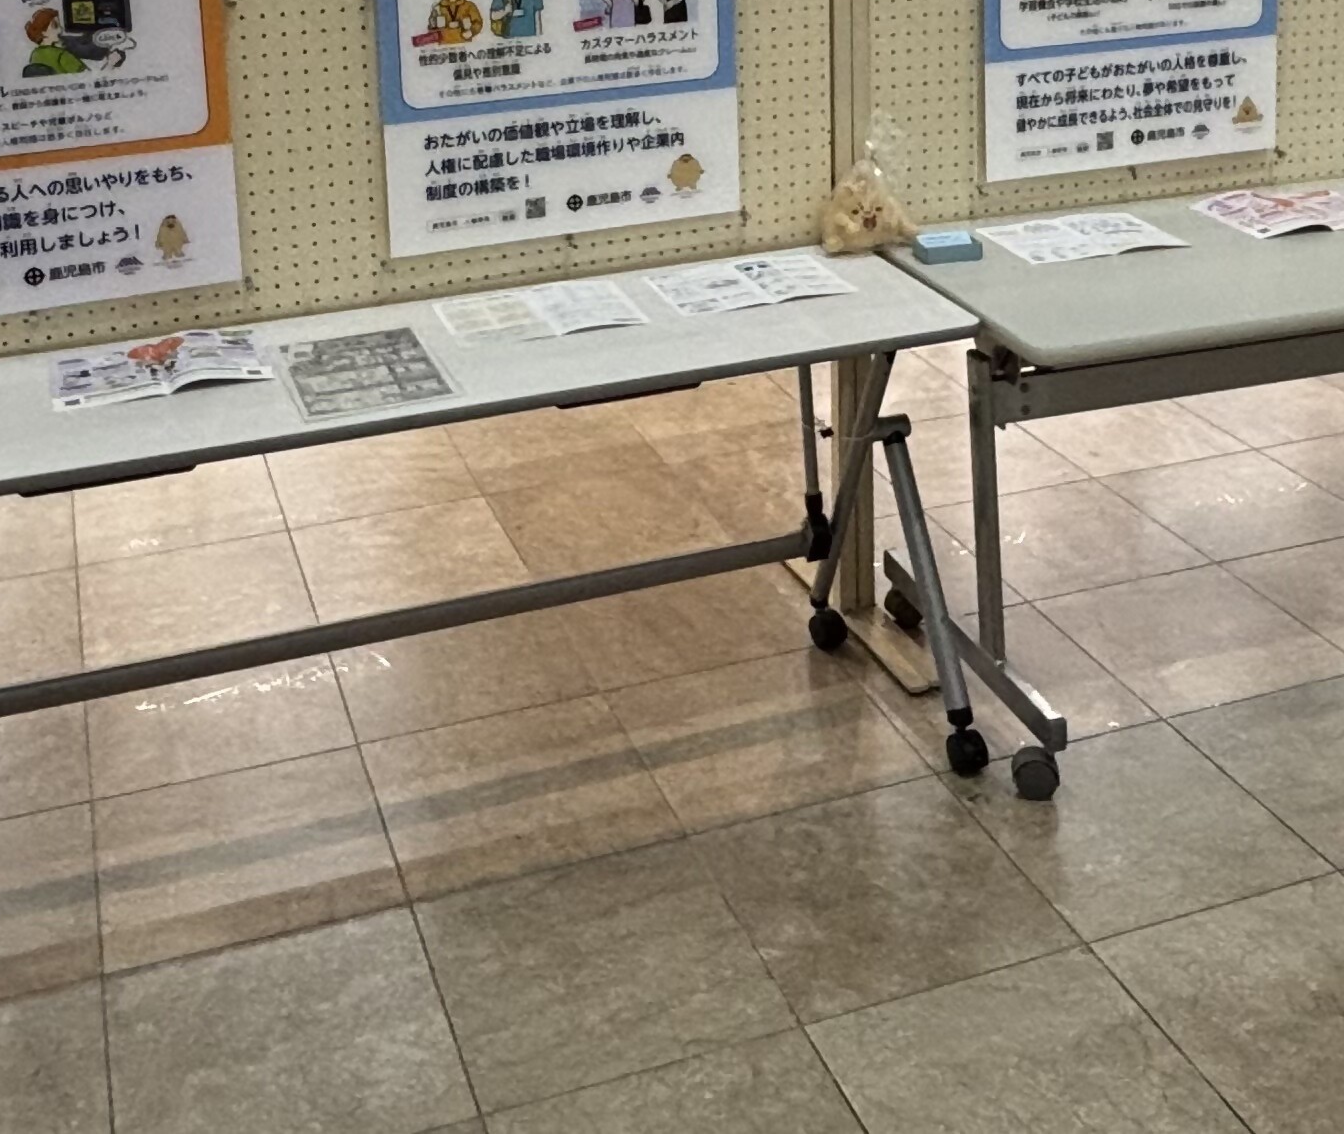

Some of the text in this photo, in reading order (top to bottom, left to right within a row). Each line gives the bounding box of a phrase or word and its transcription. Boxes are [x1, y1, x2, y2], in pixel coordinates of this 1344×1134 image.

[581, 27, 699, 50] カスタマーハラスメント
[424, 110, 661, 151] おたがいの価値観や立場を理解し、
